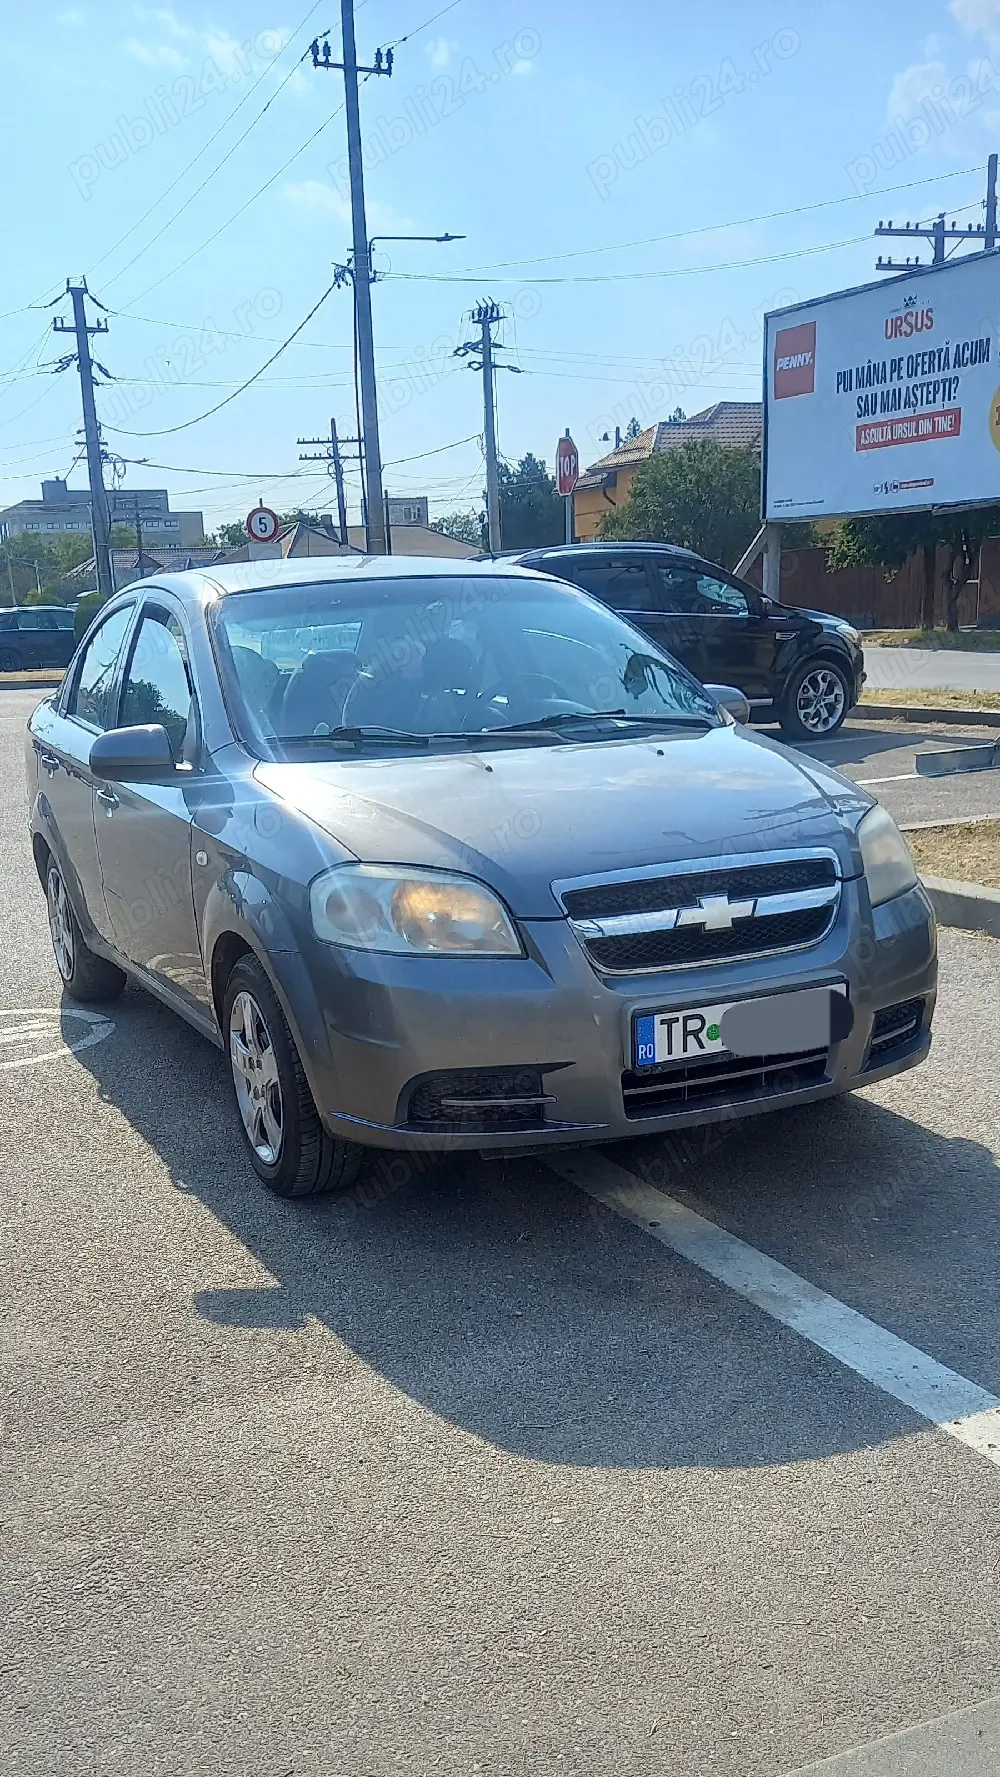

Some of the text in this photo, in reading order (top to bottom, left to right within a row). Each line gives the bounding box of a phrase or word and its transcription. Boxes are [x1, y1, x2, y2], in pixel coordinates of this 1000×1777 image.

[884, 307, 934, 340] URSUS
[836, 337, 991, 394] PUI MÂNA PE OFERTĂ ACUM
[856, 376, 960, 418] SAU MAI AȘTEPȚI?
[893, 421, 917, 440] URSUL
[918, 417, 933, 436] DIN
[933, 413, 955, 432] TINE!
[559, 454, 576, 478] TOP
[258, 516, 268, 533] 5
[659, 1013, 706, 1056] TR
[638, 1043, 654, 1060] RO
